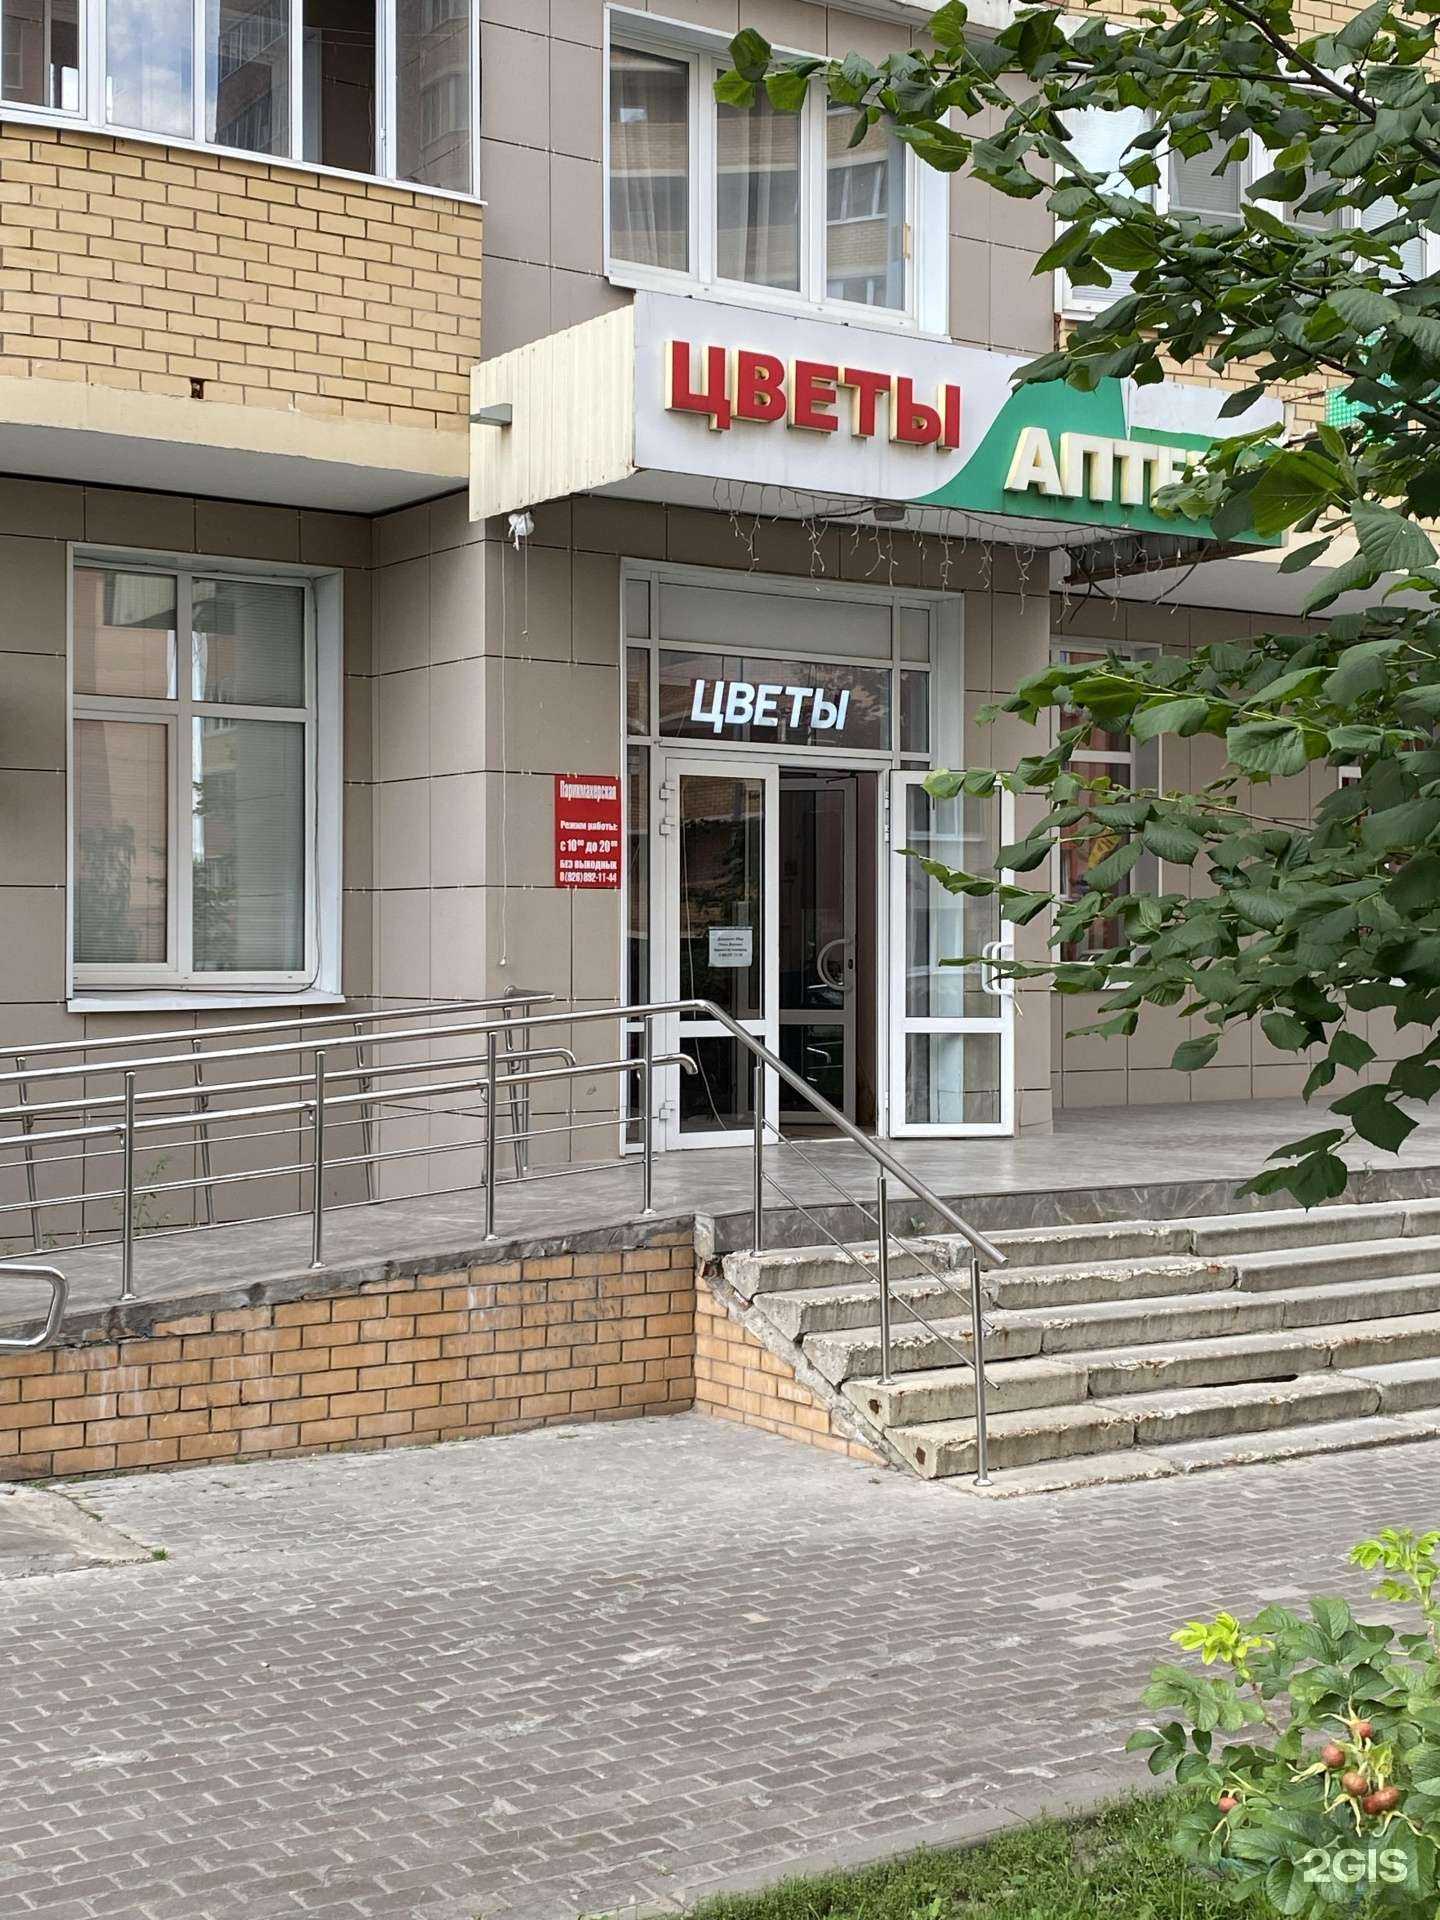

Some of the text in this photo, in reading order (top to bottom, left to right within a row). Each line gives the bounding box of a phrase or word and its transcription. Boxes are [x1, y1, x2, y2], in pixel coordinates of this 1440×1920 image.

[664, 339, 961, 451] ЦВЕТЫ
[1004, 426, 1208, 505] АПТЕ
[691, 679, 850, 734] ЦВЕТЫ
[560, 820, 618, 831] Режим работы:
[585, 841, 597, 854] до
